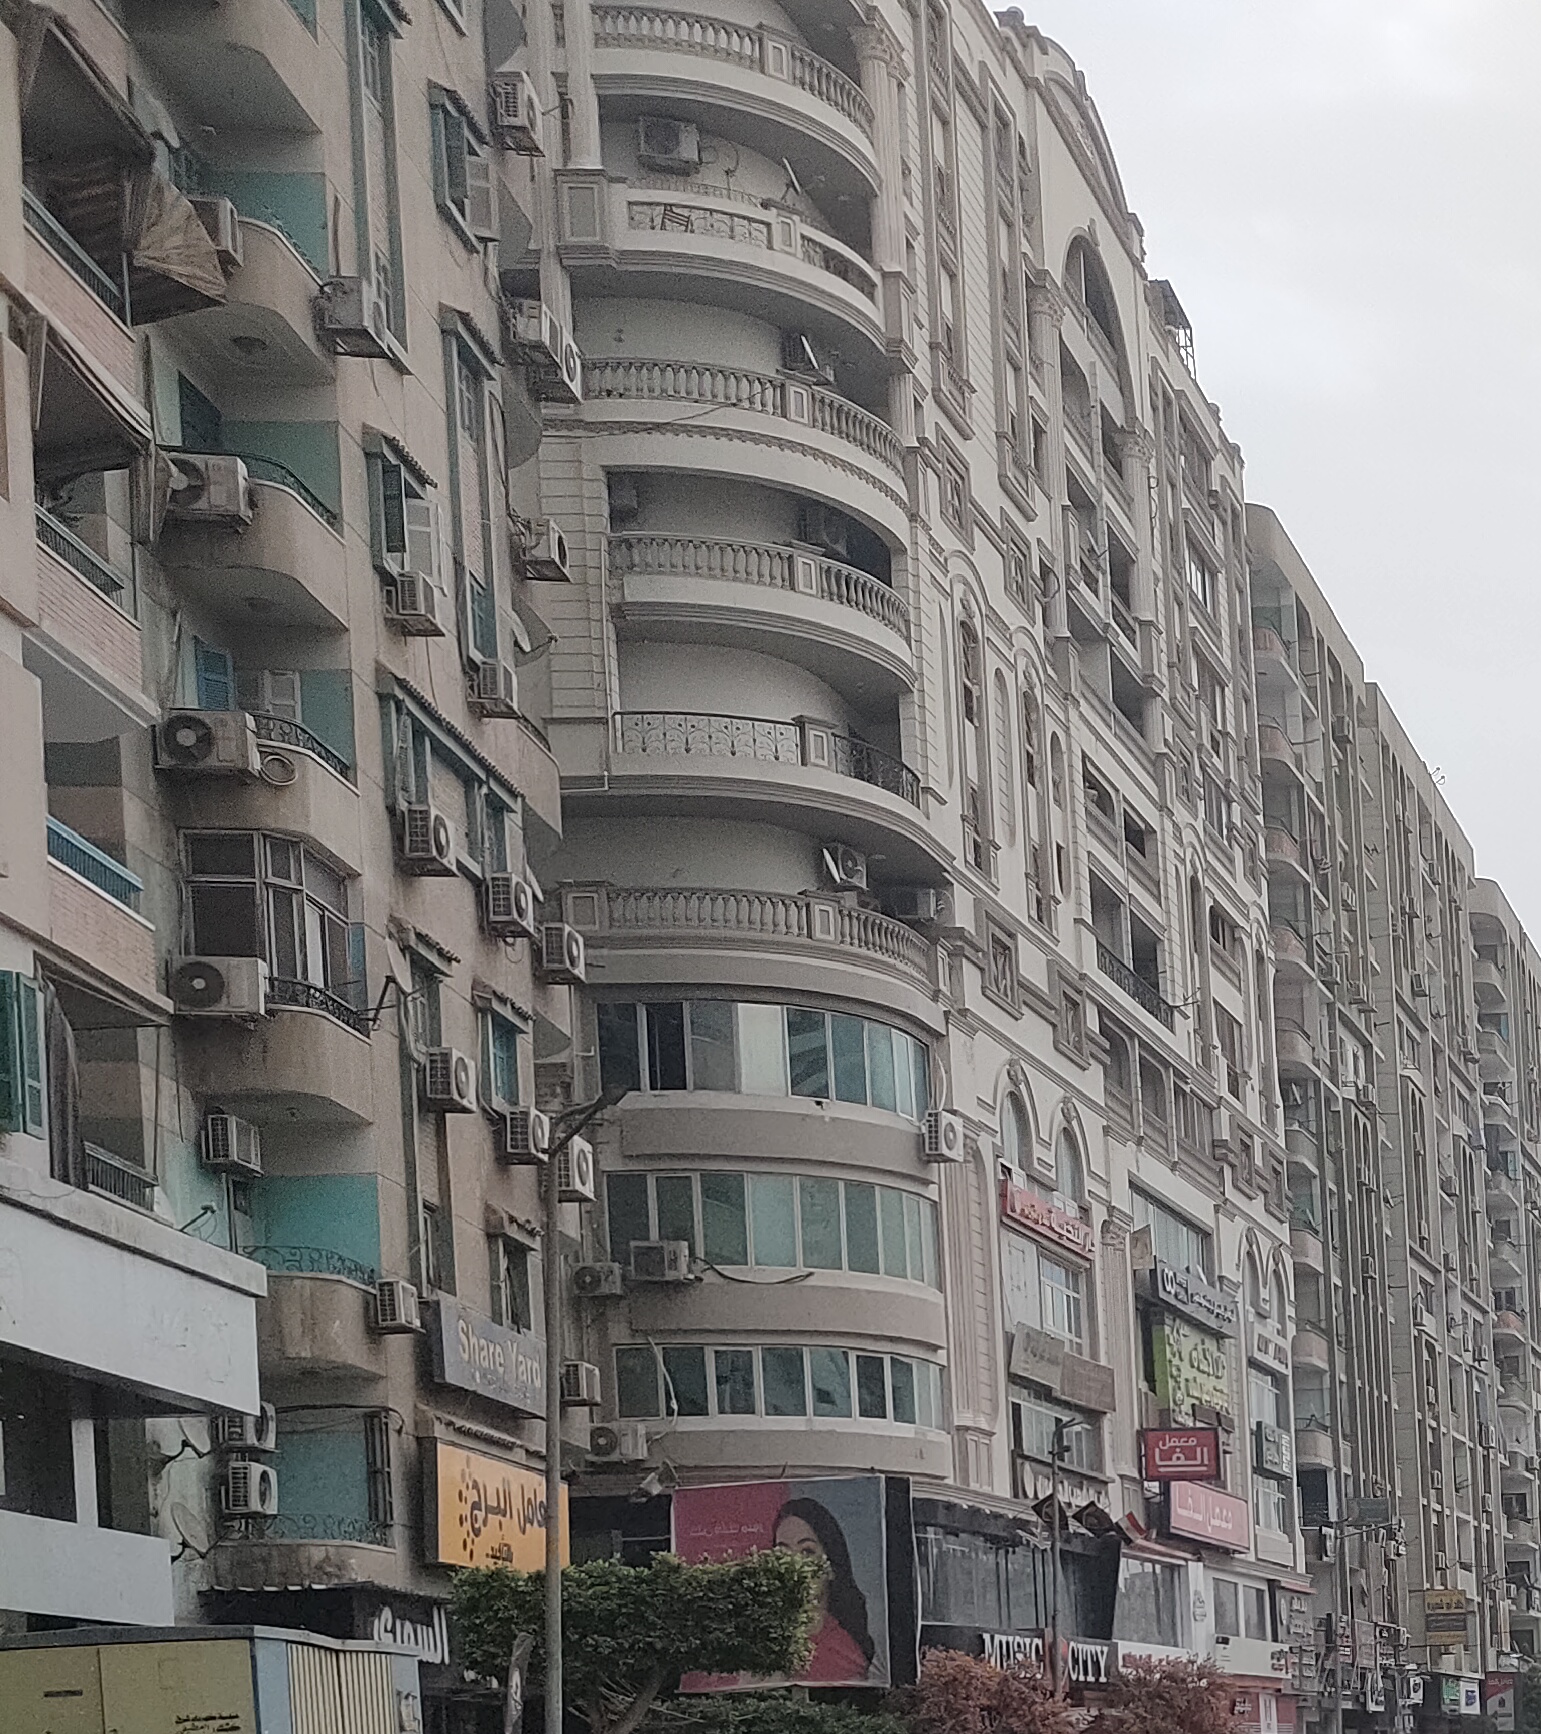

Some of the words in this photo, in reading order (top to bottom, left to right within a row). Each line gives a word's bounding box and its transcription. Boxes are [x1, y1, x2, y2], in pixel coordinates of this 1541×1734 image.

[458, 1319, 505, 1374] Share
[508, 1340, 541, 1388] Yard
[1154, 1447, 1209, 1465] الفا
[1159, 1434, 1198, 1450] معمل
[516, 1483, 547, 1536] عامل
[1068, 1641, 1109, 1683] CITY
